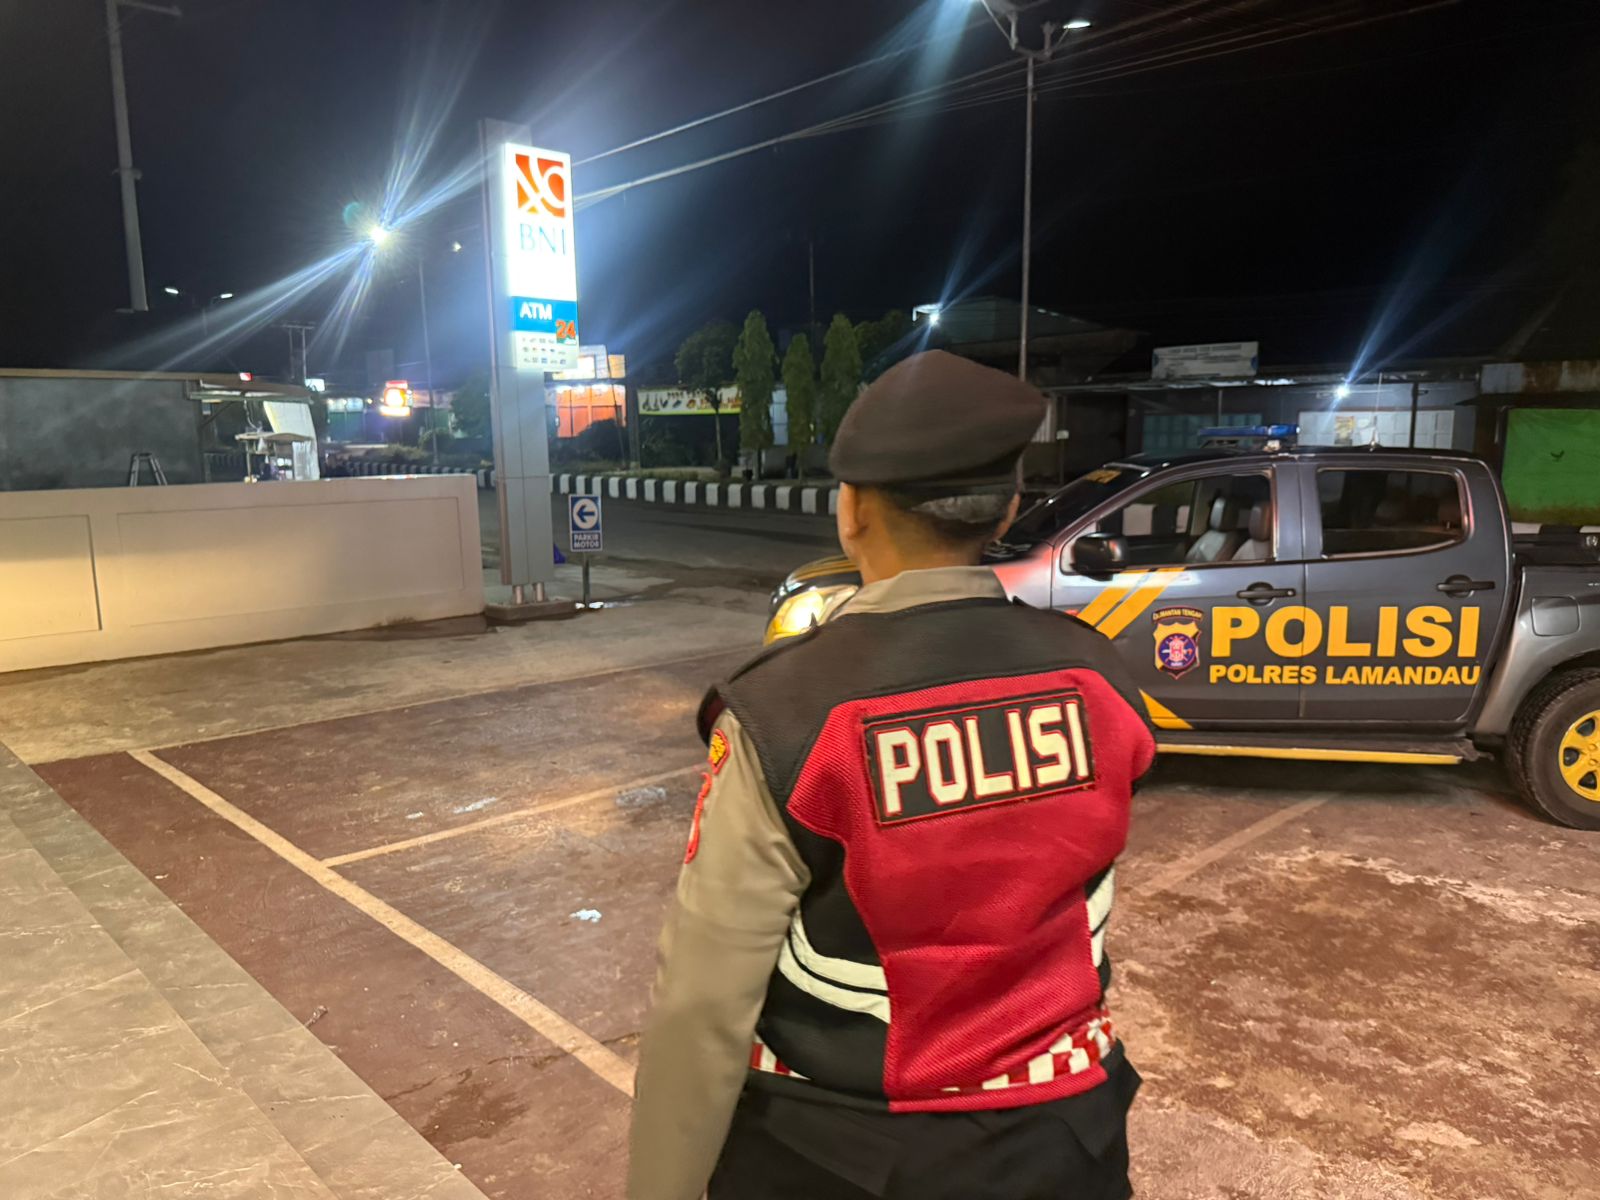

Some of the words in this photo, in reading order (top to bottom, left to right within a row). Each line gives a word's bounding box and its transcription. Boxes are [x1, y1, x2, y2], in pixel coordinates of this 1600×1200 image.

[520, 223, 566, 255] BNI
[520, 301, 552, 320] ATM
[556, 319, 576, 339] 24
[573, 533, 599, 541] PARKIR
[573, 540, 600, 548] MOTOR
[1211, 605, 1480, 658] POLISI
[1209, 664, 1317, 684] POLRES
[1325, 665, 1481, 685] LAMANDAU
[874, 700, 1089, 817] POLISI
